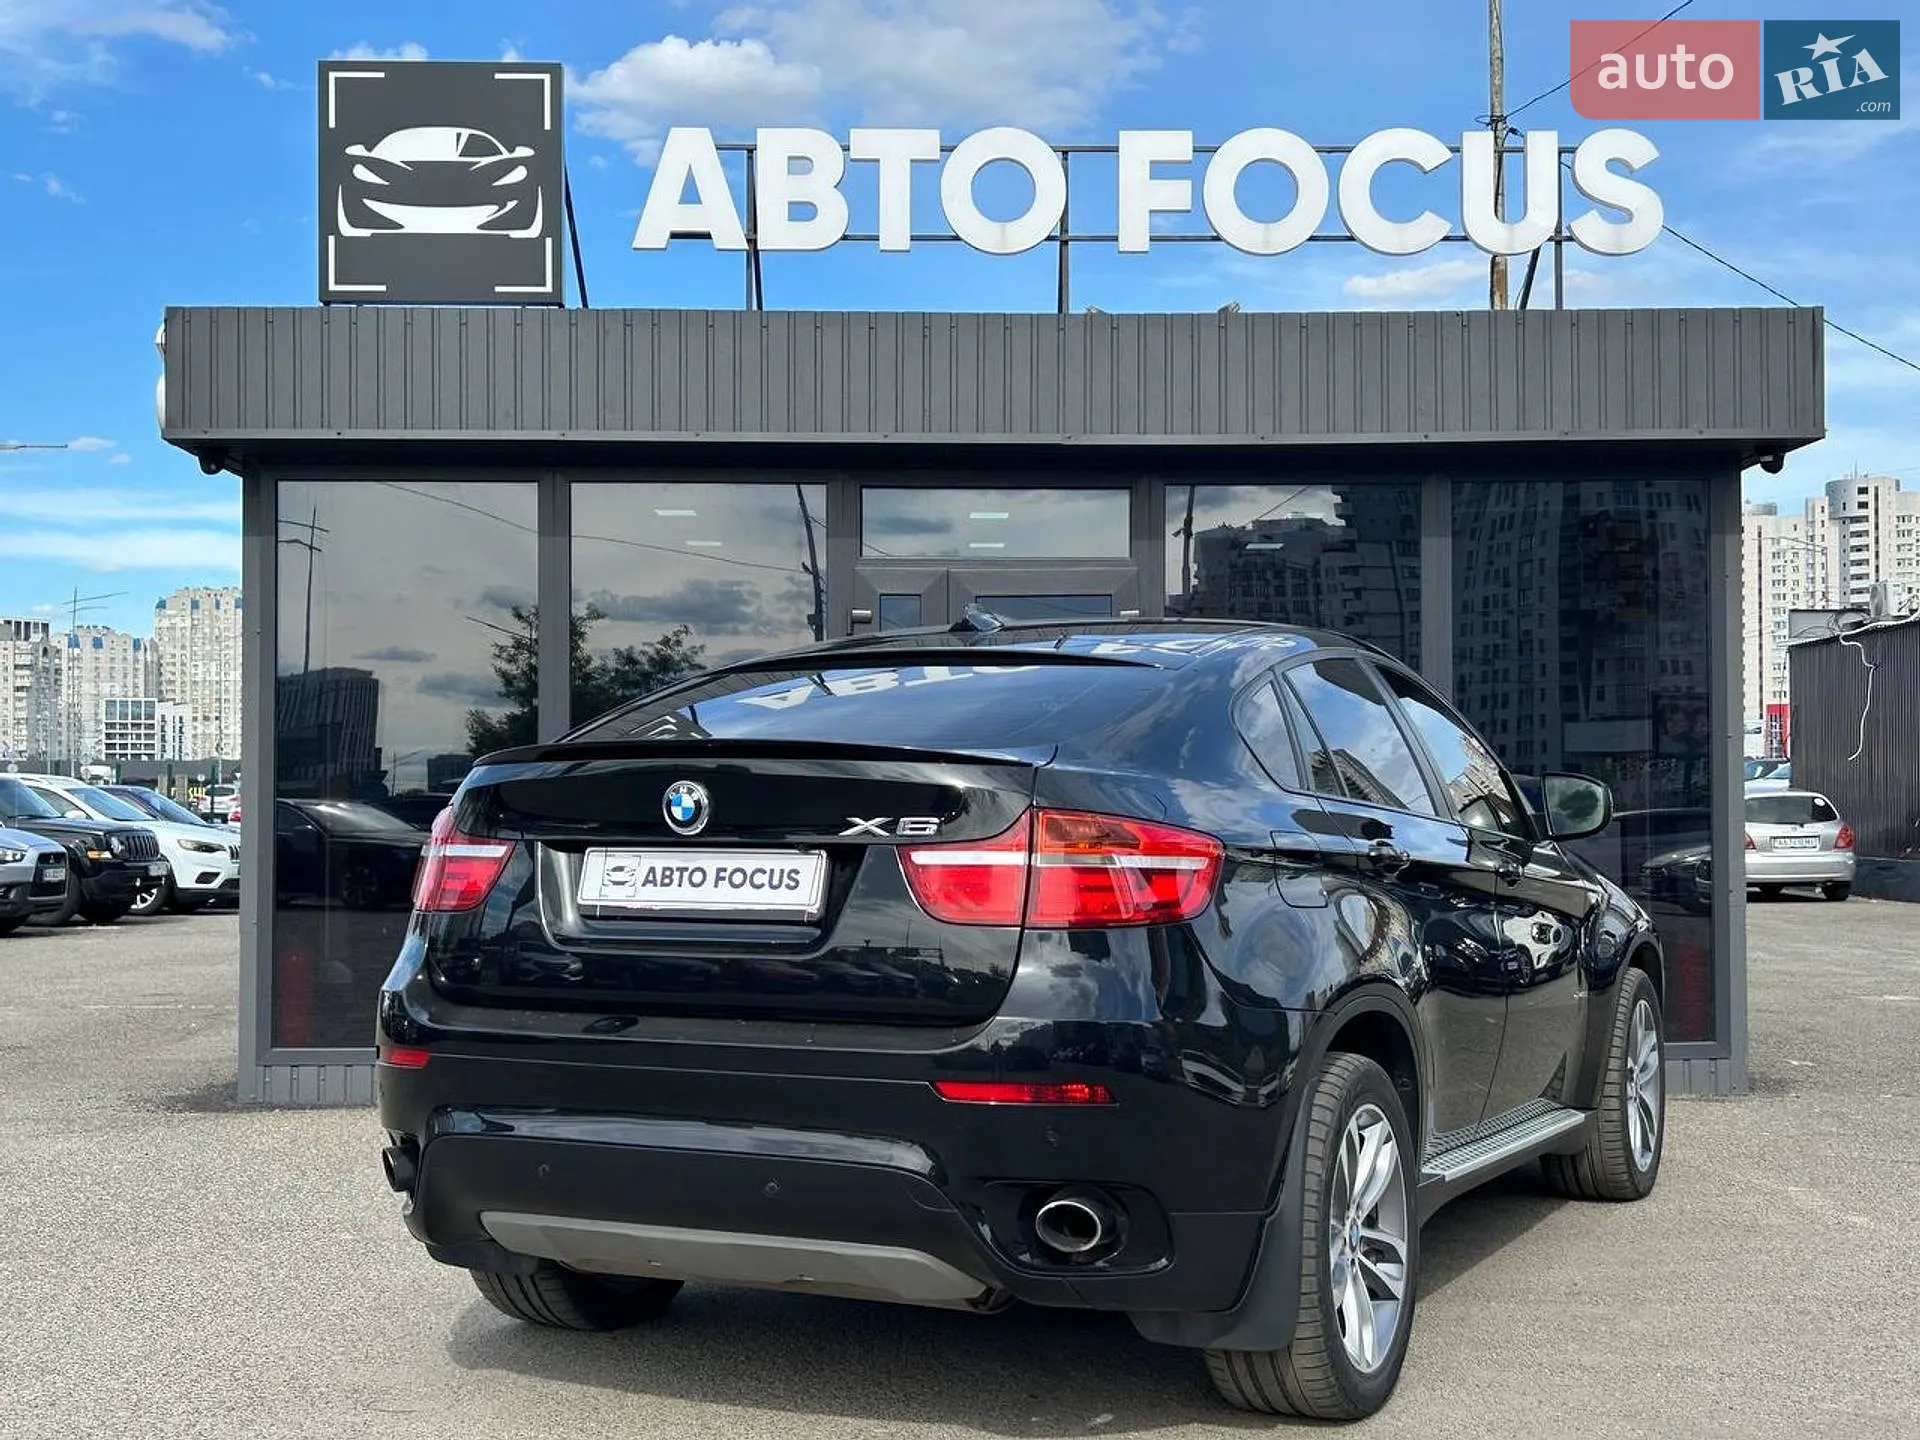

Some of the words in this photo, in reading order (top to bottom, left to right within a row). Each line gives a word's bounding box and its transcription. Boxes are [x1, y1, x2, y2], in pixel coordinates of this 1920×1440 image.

[1117, 127, 1665, 256] FOCUS
[838, 817, 940, 836] X6
[713, 866, 801, 891] FOCUS
